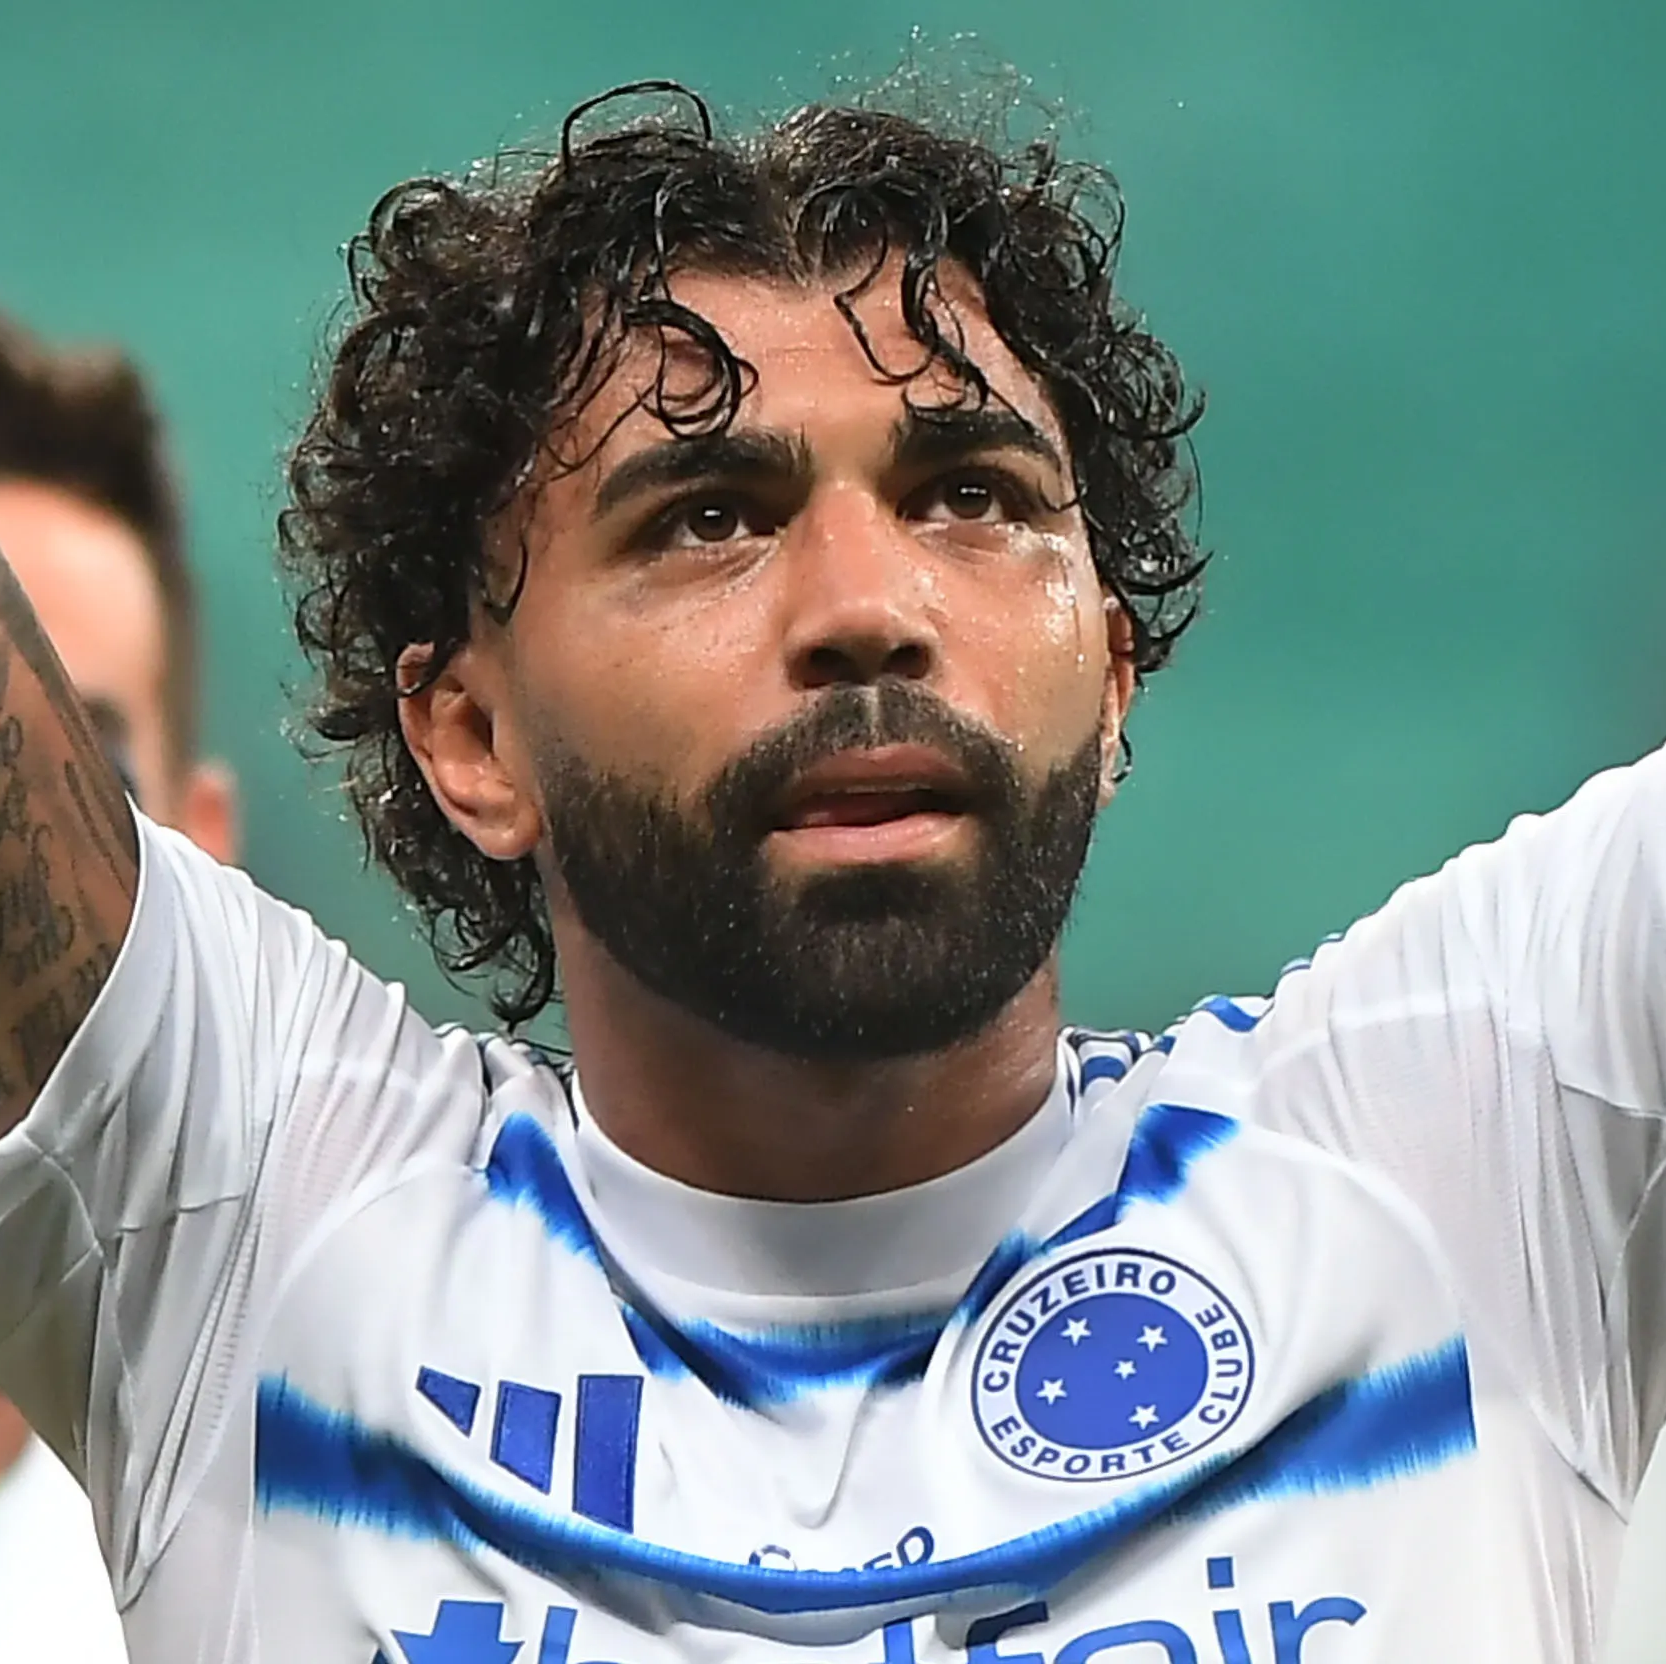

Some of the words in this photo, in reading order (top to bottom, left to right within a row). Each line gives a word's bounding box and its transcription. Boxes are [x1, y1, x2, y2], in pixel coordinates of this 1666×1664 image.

[982, 1261, 1177, 1393] CRUZEIRO
[990, 1415, 1191, 1475] ESPORTE
[1195, 1302, 1244, 1425] CLUBE
